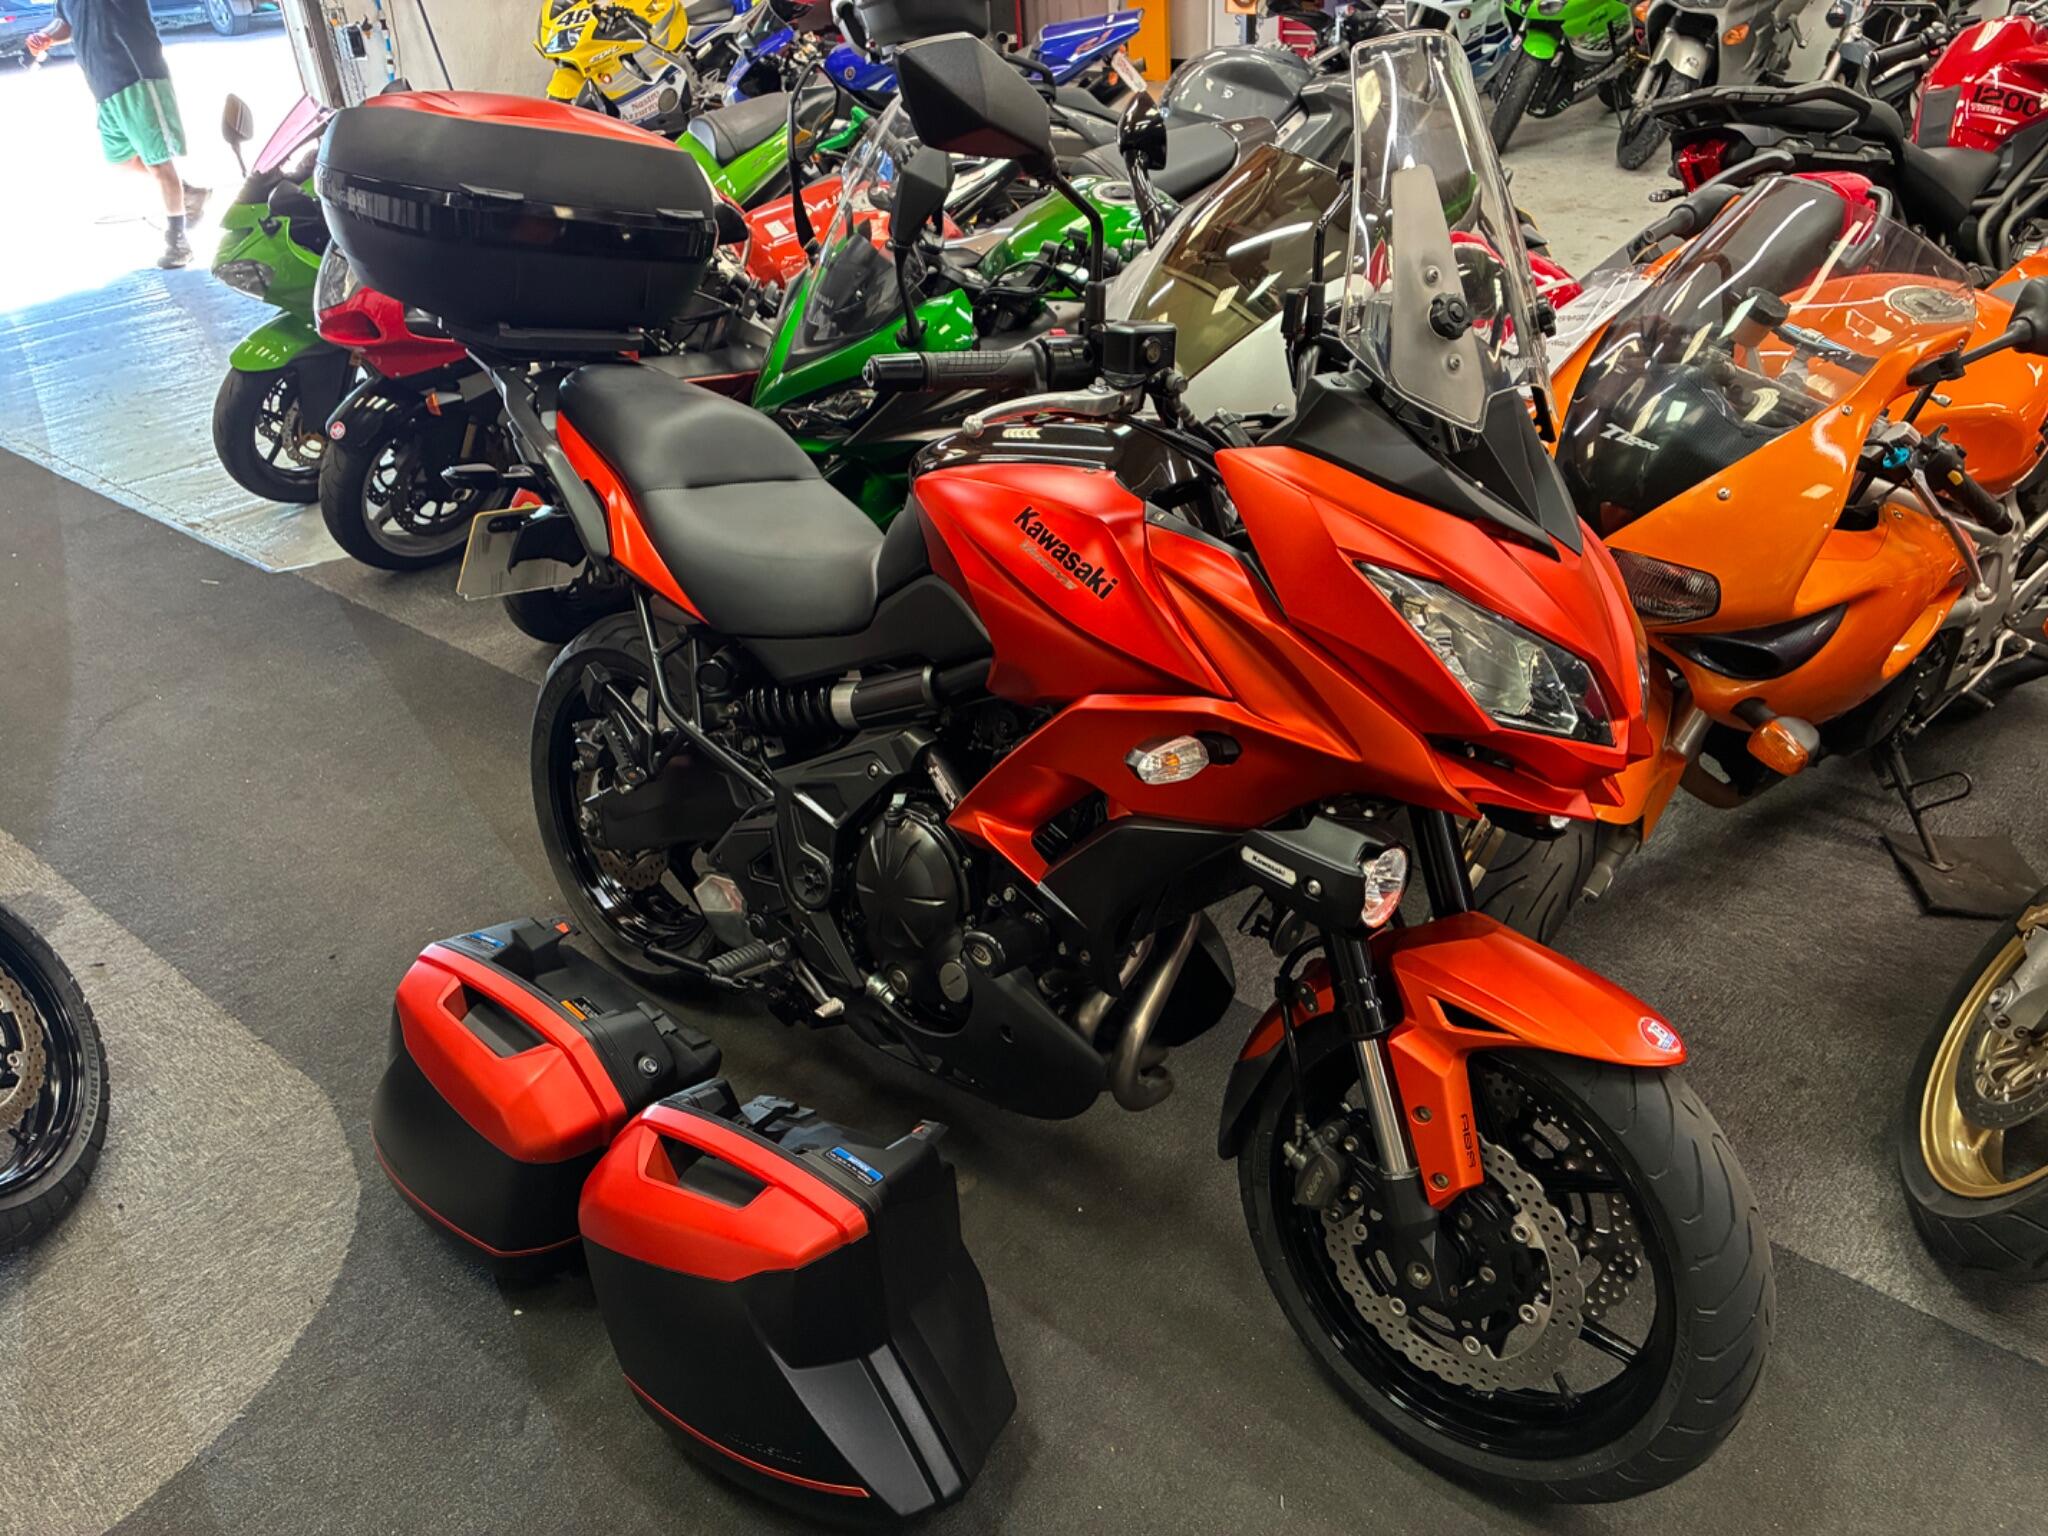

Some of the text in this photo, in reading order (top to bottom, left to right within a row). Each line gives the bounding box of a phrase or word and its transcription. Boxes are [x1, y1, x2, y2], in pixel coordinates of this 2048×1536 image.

[556, 8, 592, 26] 46
[1973, 84, 2041, 117] 1200
[1013, 505, 1119, 600] Kawasaki
